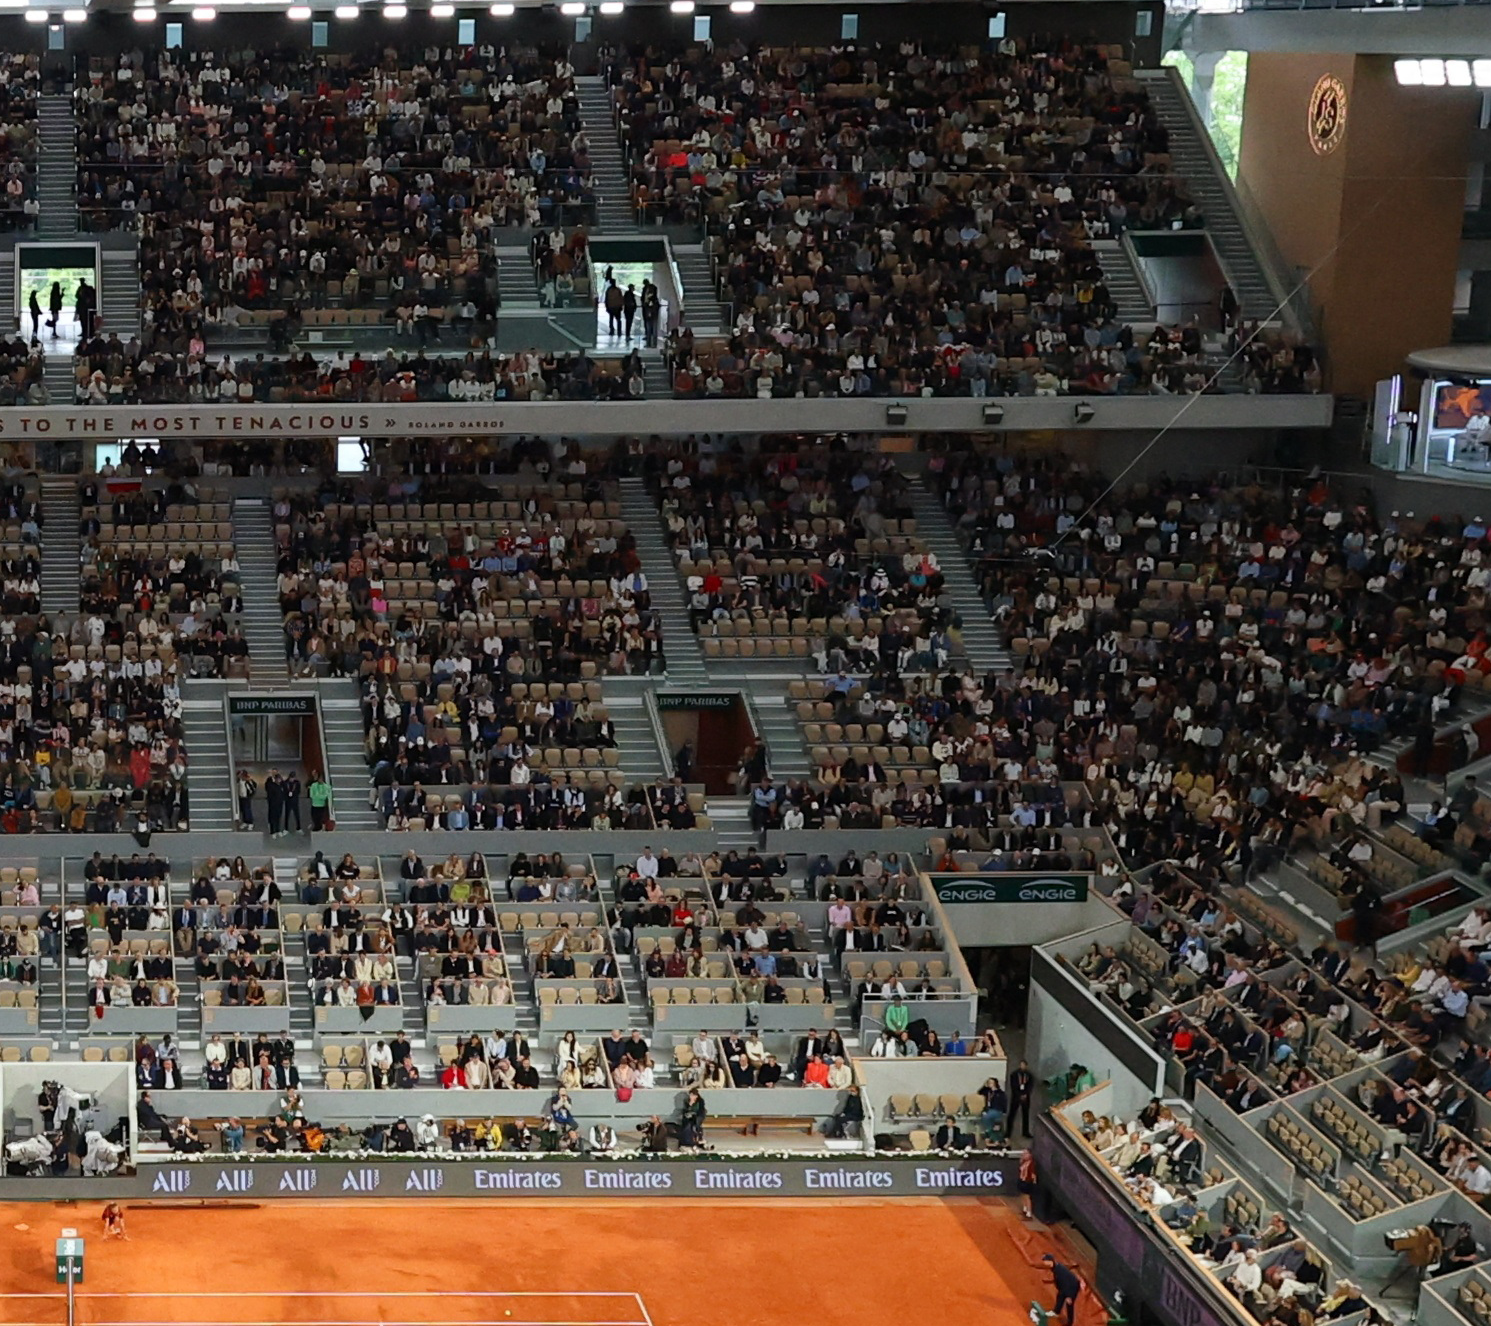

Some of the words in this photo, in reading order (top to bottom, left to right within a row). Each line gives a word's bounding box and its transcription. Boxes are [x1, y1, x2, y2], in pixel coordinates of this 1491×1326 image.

[20, 418, 51, 433] TO
[66, 418, 114, 432] THE
[131, 417, 201, 432] MOST
[216, 415, 370, 432] TENACIOUS
[408, 421, 454, 429] ROLAND
[459, 420, 505, 429] GARROS
[236, 700, 260, 710] BNP
[261, 700, 308, 710] PARIBAS
[659, 697, 683, 706] BNP
[684, 697, 731, 707] PARIBAS
[475, 1168, 562, 1189] Emirates
[585, 1168, 672, 1189] Emirates
[695, 1168, 782, 1189] Emirates
[805, 1168, 892, 1189] Emirates
[916, 1168, 1003, 1189] Emirates
